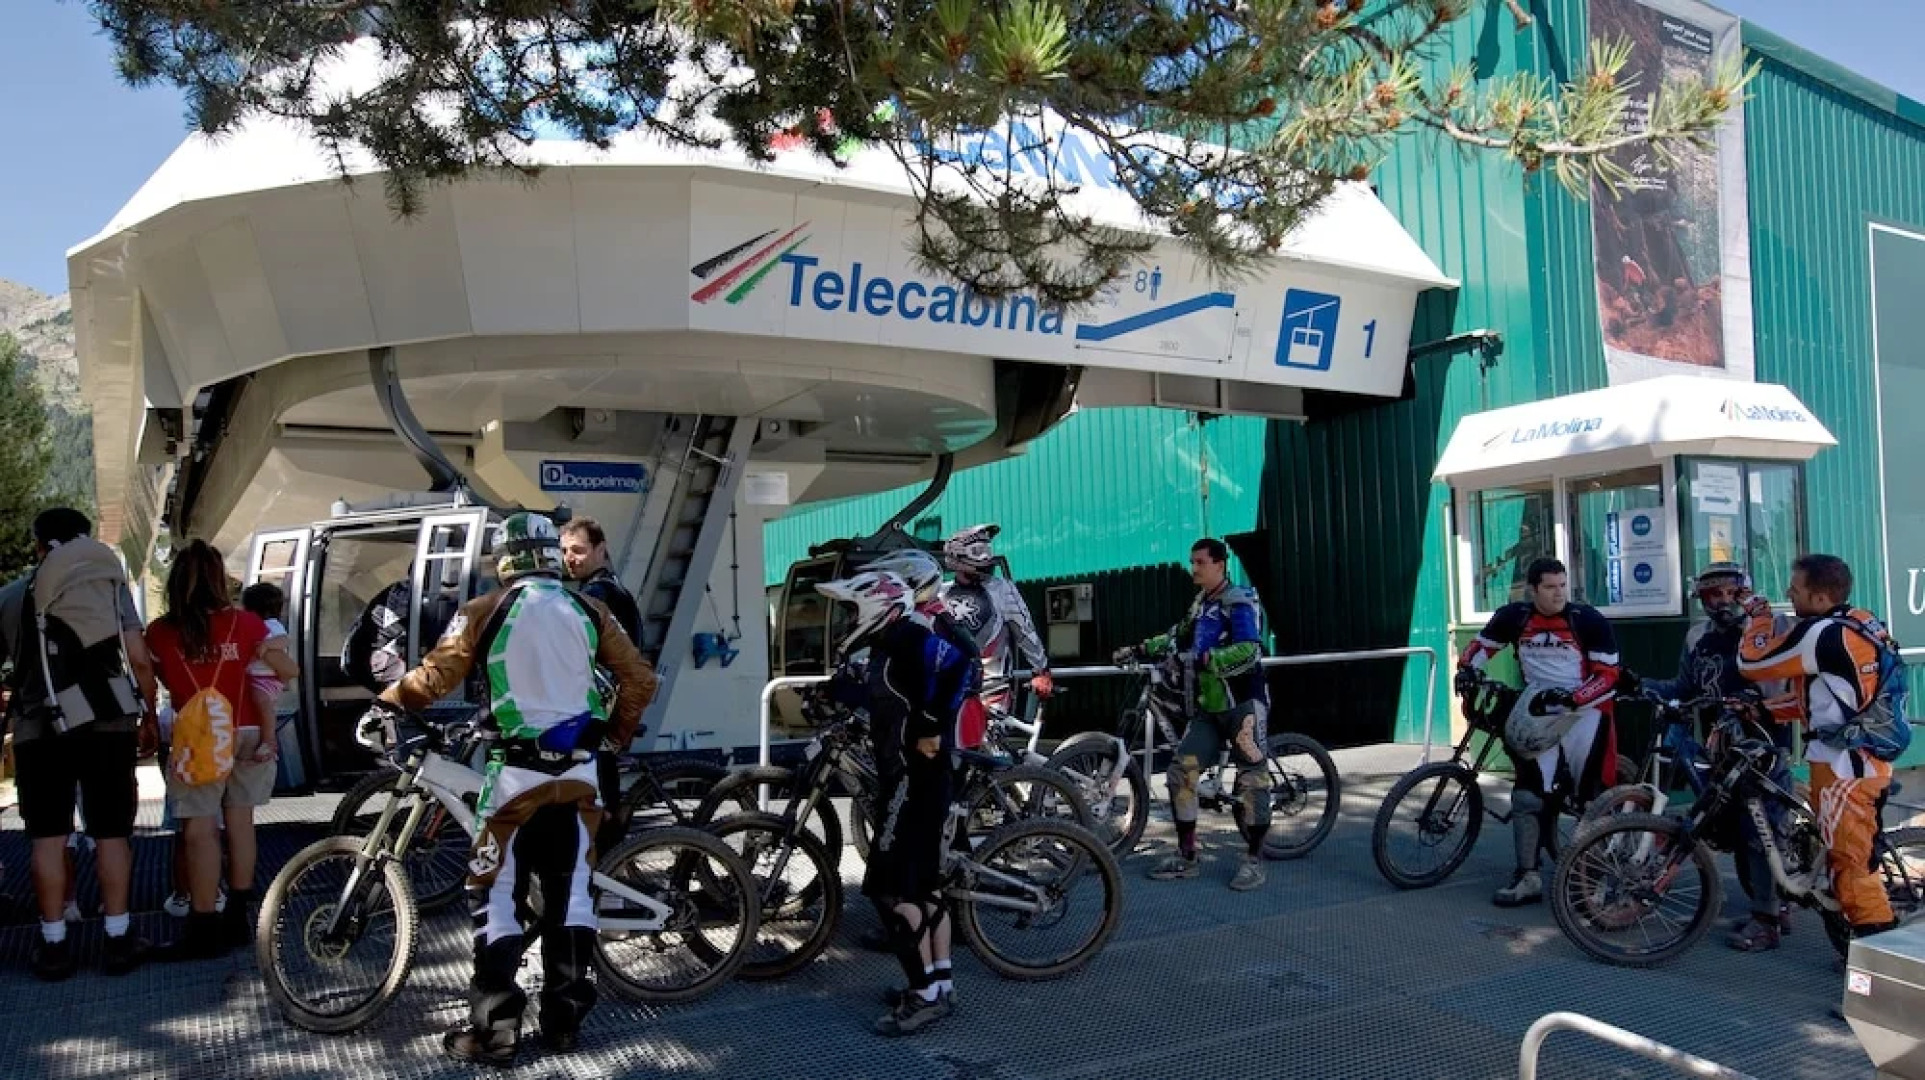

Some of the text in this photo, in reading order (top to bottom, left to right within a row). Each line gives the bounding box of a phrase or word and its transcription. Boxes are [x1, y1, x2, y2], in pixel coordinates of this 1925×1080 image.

[781, 254, 1064, 336] Telecabina
[1134, 269, 1148, 293] 8
[1363, 319, 1377, 359] 1
